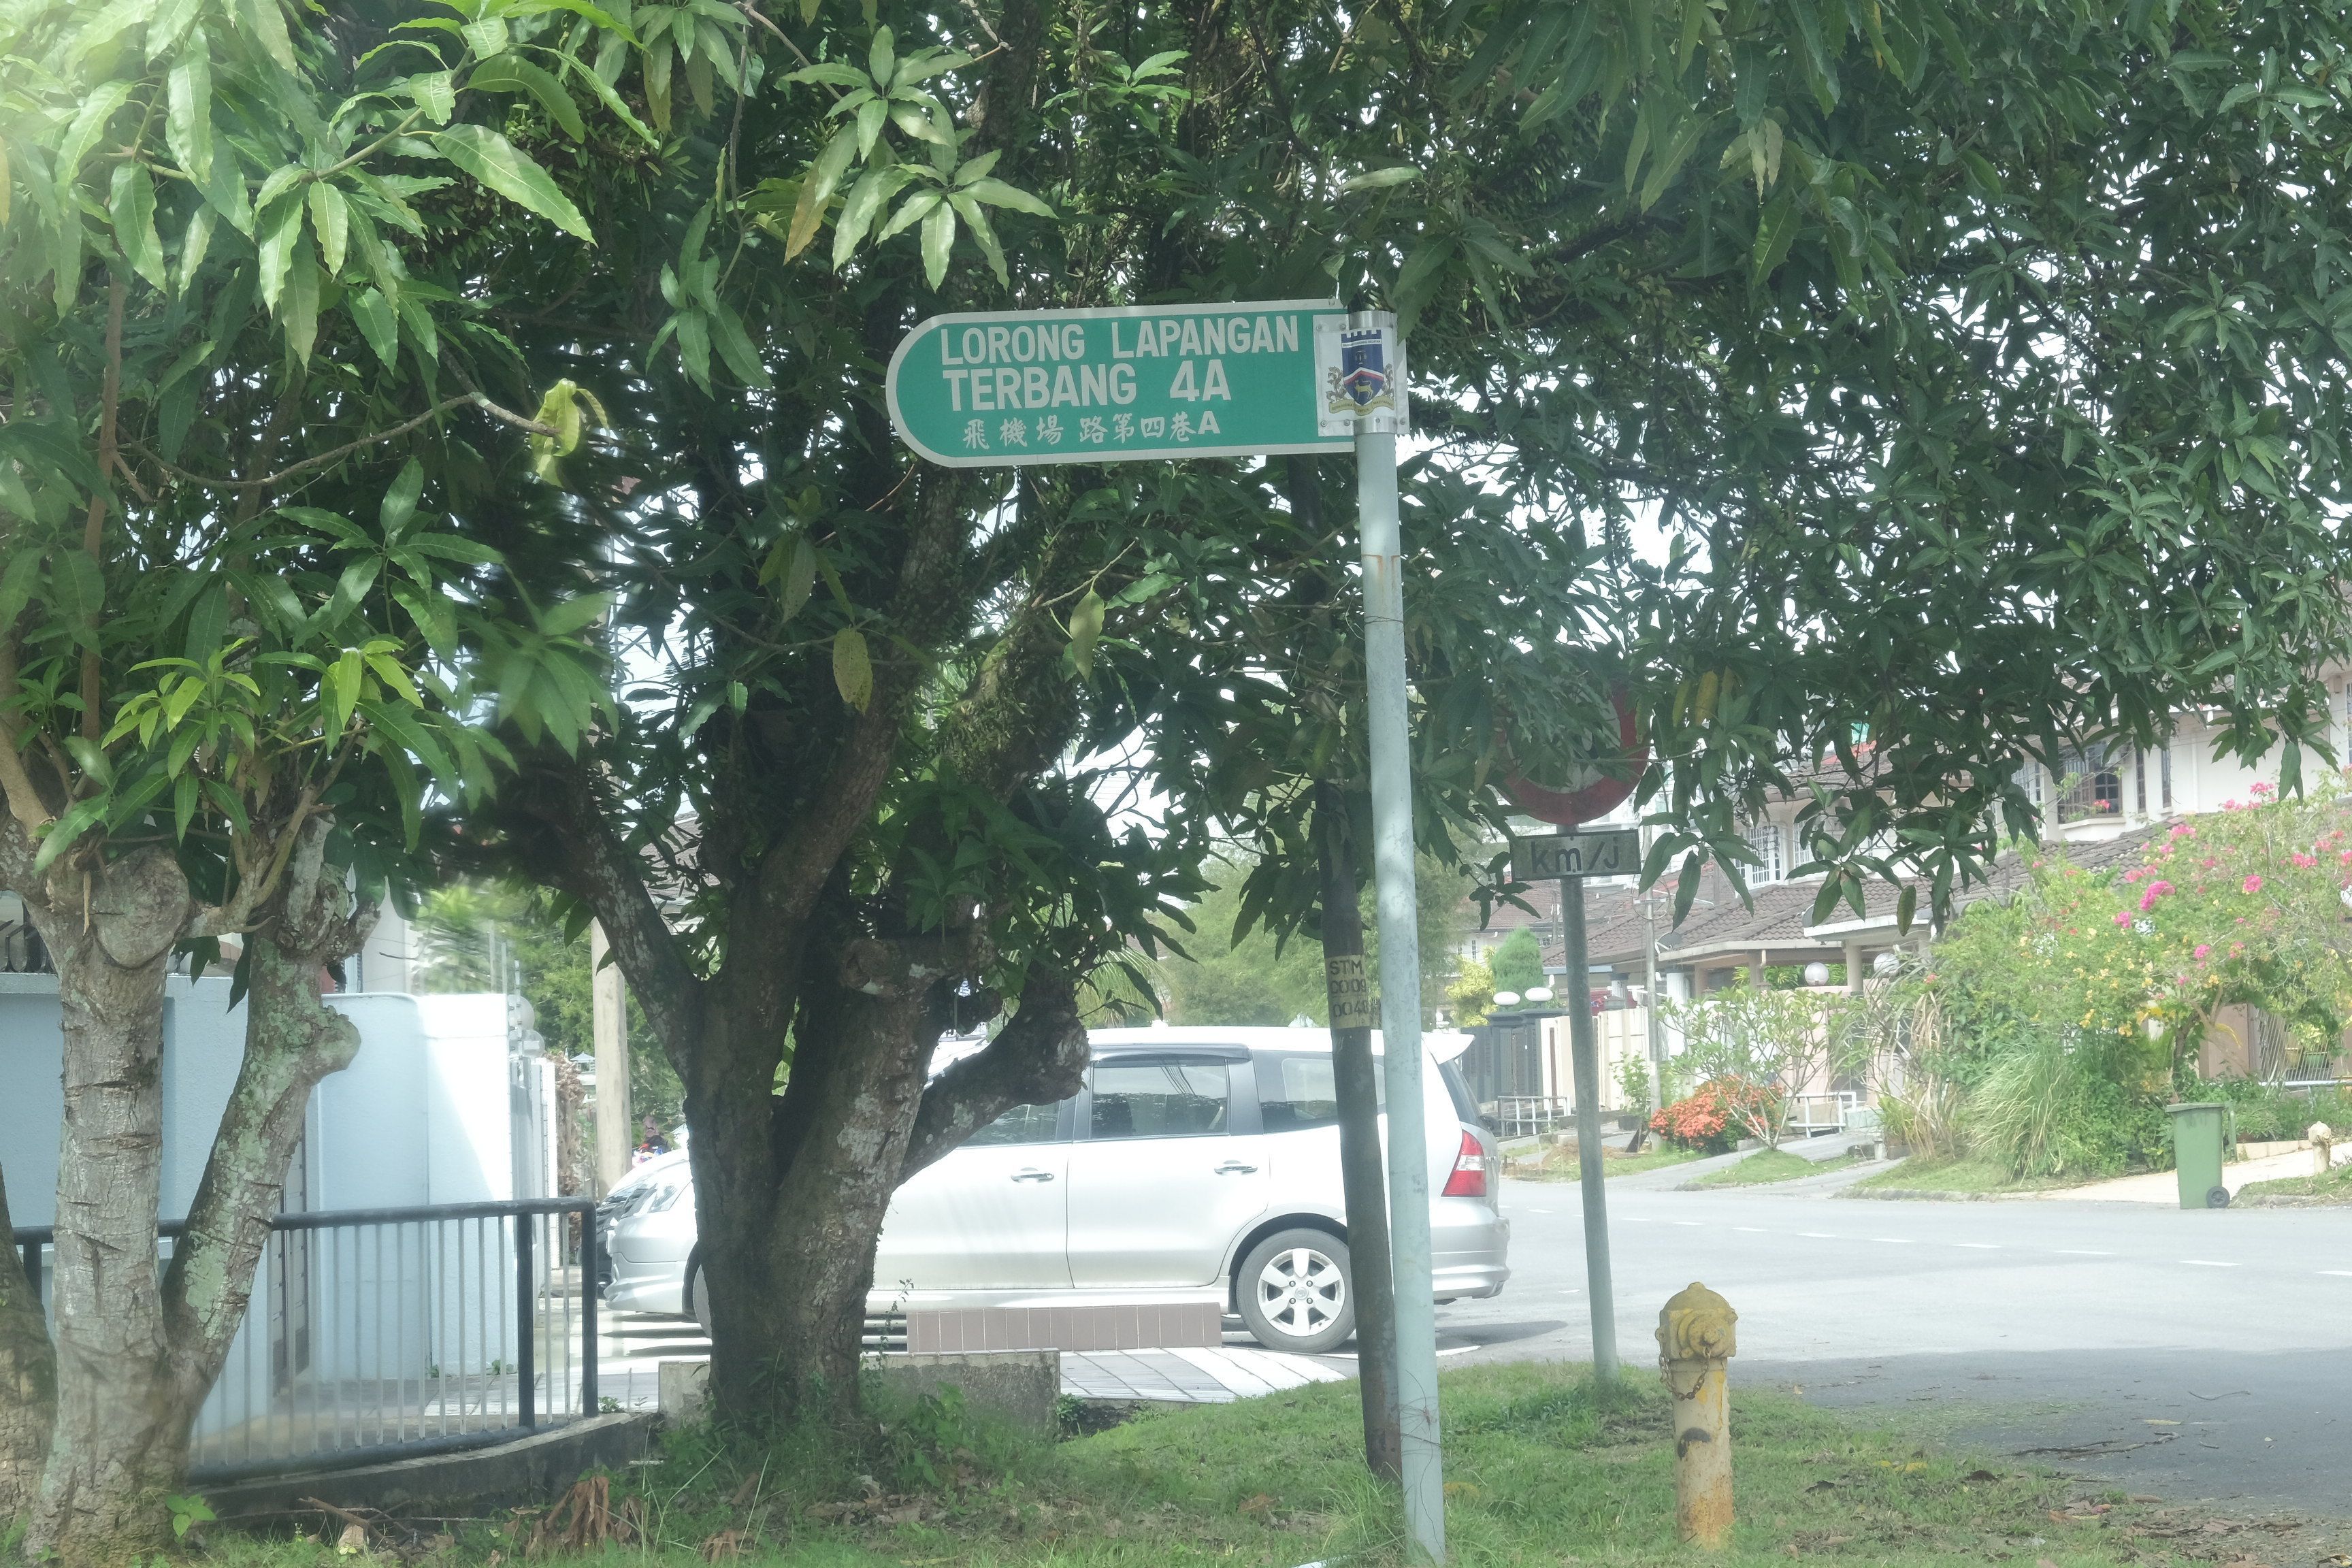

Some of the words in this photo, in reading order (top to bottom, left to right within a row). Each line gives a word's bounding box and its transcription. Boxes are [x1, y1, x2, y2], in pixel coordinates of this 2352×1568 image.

[941, 323, 1085, 365] LORONG
[1111, 315, 1299, 359] LAPANGAN
[943, 363, 1137, 412] TERBANG
[1169, 359, 1232, 402] 4A
[1531, 836, 1620, 873] km/j
[1329, 959, 1363, 975] STM
